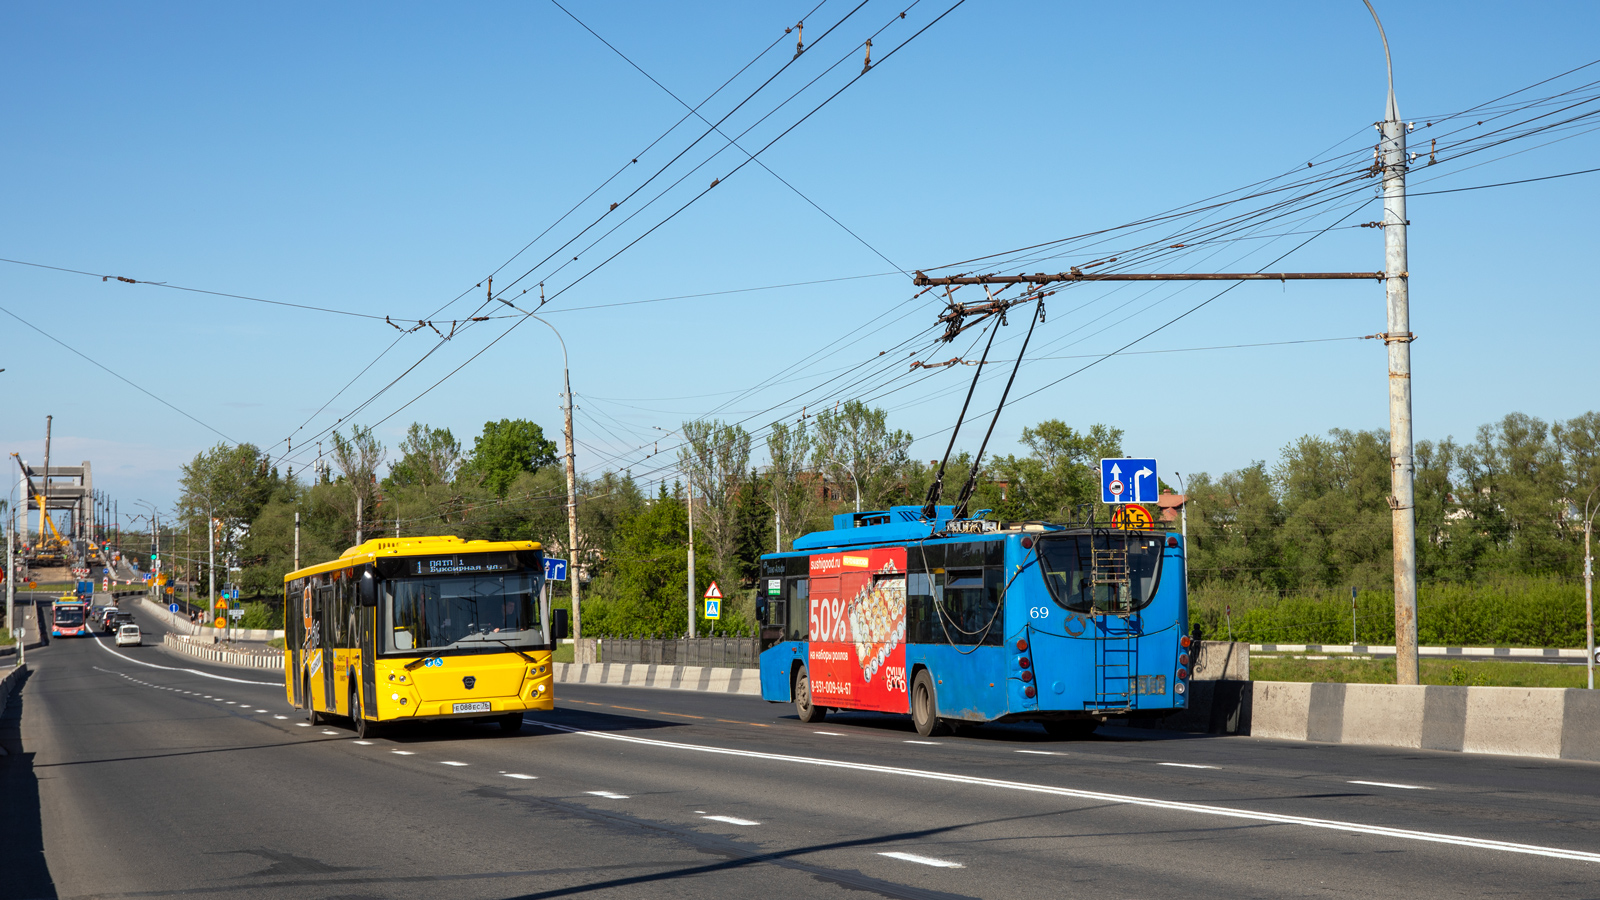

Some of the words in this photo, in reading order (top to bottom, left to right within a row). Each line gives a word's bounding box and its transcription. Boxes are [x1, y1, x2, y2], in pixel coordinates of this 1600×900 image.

[417, 560, 422, 573] 1
[811, 557, 840, 572] sushigood.ru
[810, 598, 846, 642] 50%
[1029, 606, 1049, 619] 69
[810, 650, 816, 660] на
[816, 649, 832, 664] наборы
[811, 680, 851, 695] 8-931-009-64-67
